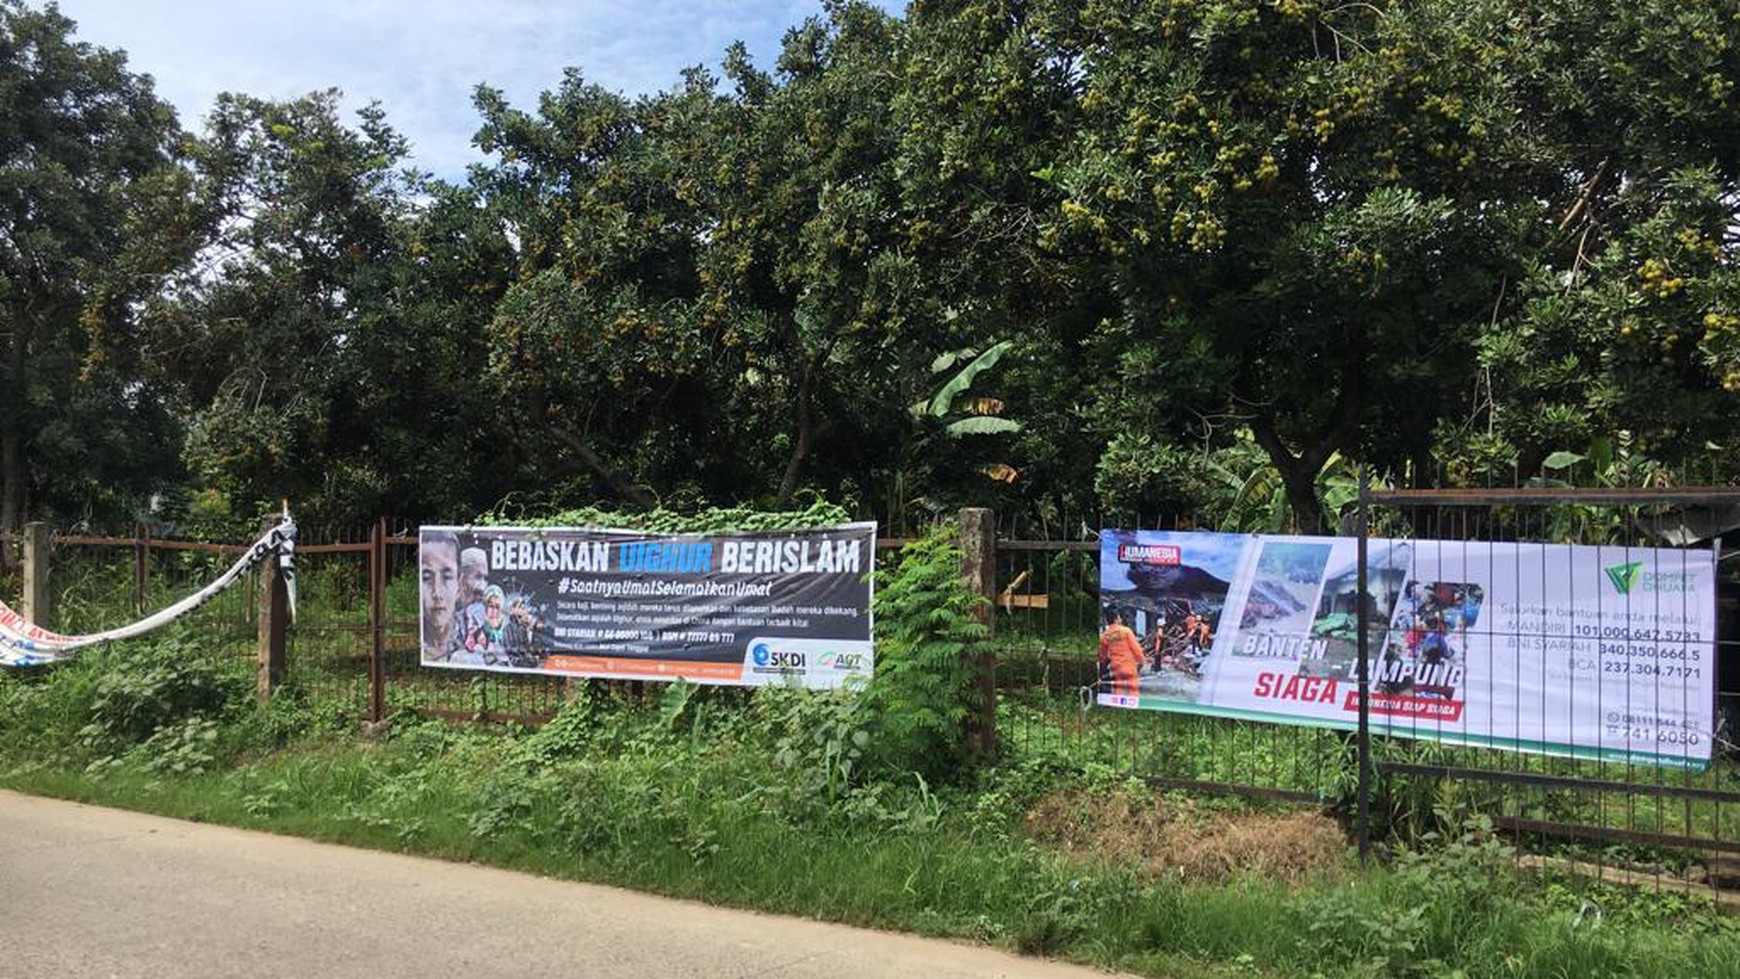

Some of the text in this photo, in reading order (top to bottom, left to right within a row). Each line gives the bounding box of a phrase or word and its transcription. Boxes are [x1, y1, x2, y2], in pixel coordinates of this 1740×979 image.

[491, 540, 609, 572] BEBASKAN
[721, 540, 861, 573] BERISLAM
[1643, 572, 1699, 580] DOMPT
[1243, 635, 1329, 660] BANTEN
[1535, 639, 1592, 652] SYARAH
[771, 652, 806, 667] SKDI
[1254, 672, 1337, 704] SIAGA
[1350, 696, 1401, 710] INONESIA
